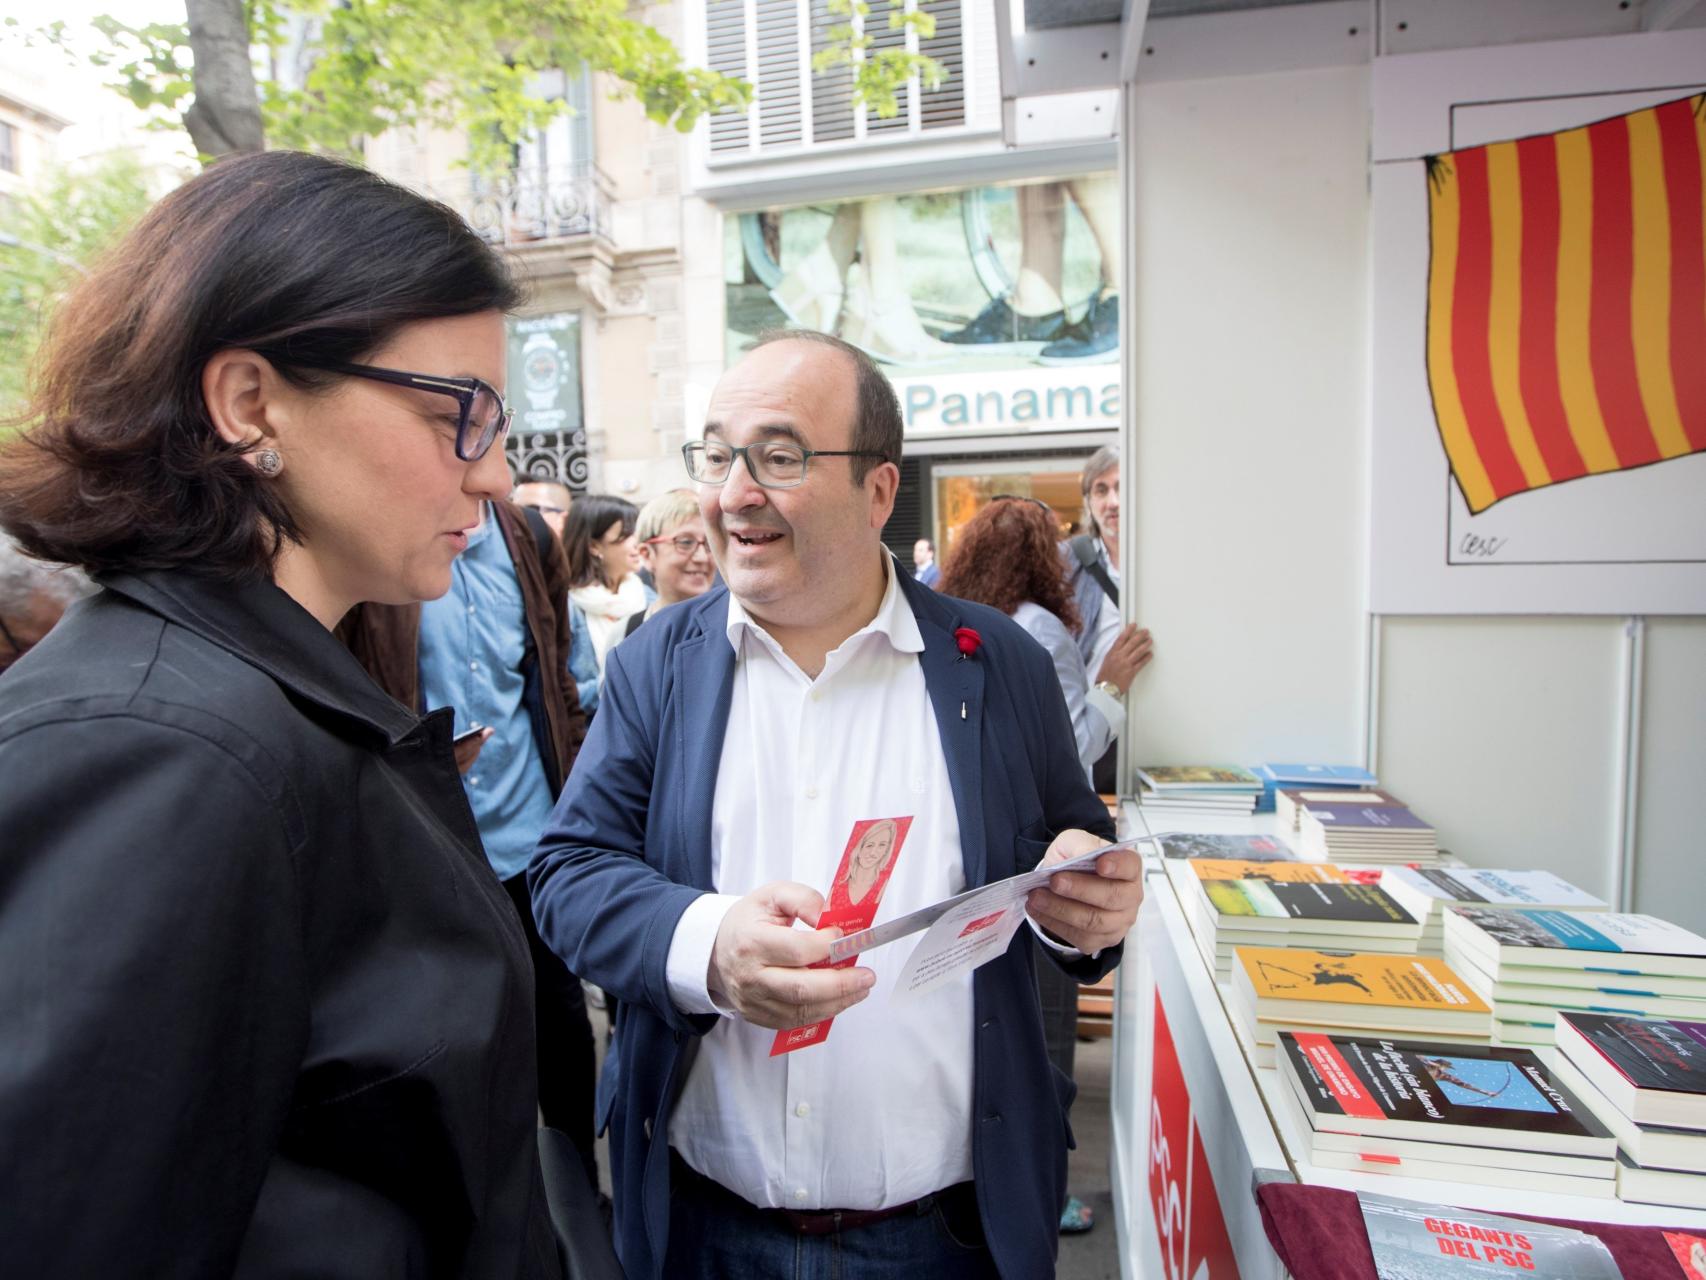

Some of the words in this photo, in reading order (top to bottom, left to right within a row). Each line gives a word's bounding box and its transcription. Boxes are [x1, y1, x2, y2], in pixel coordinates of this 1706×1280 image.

[905, 384, 1120, 426] Panama
[1371, 1052, 1388, 1062] de
[1379, 1040, 1394, 1051] La
[1378, 1062, 1393, 1070] la
[1382, 1049, 1410, 1073] flecha
[1383, 1070, 1413, 1100] historia
[1400, 1072, 1422, 1087] (sin
[1522, 1065, 1556, 1092] Manuel
[1548, 1092, 1573, 1112] Cruz
[1412, 1087, 1445, 1119] blanco)
[1424, 1217, 1533, 1250] GEGANTS
[1437, 1237, 1481, 1261] DEL
[1483, 1245, 1536, 1271] PSC
